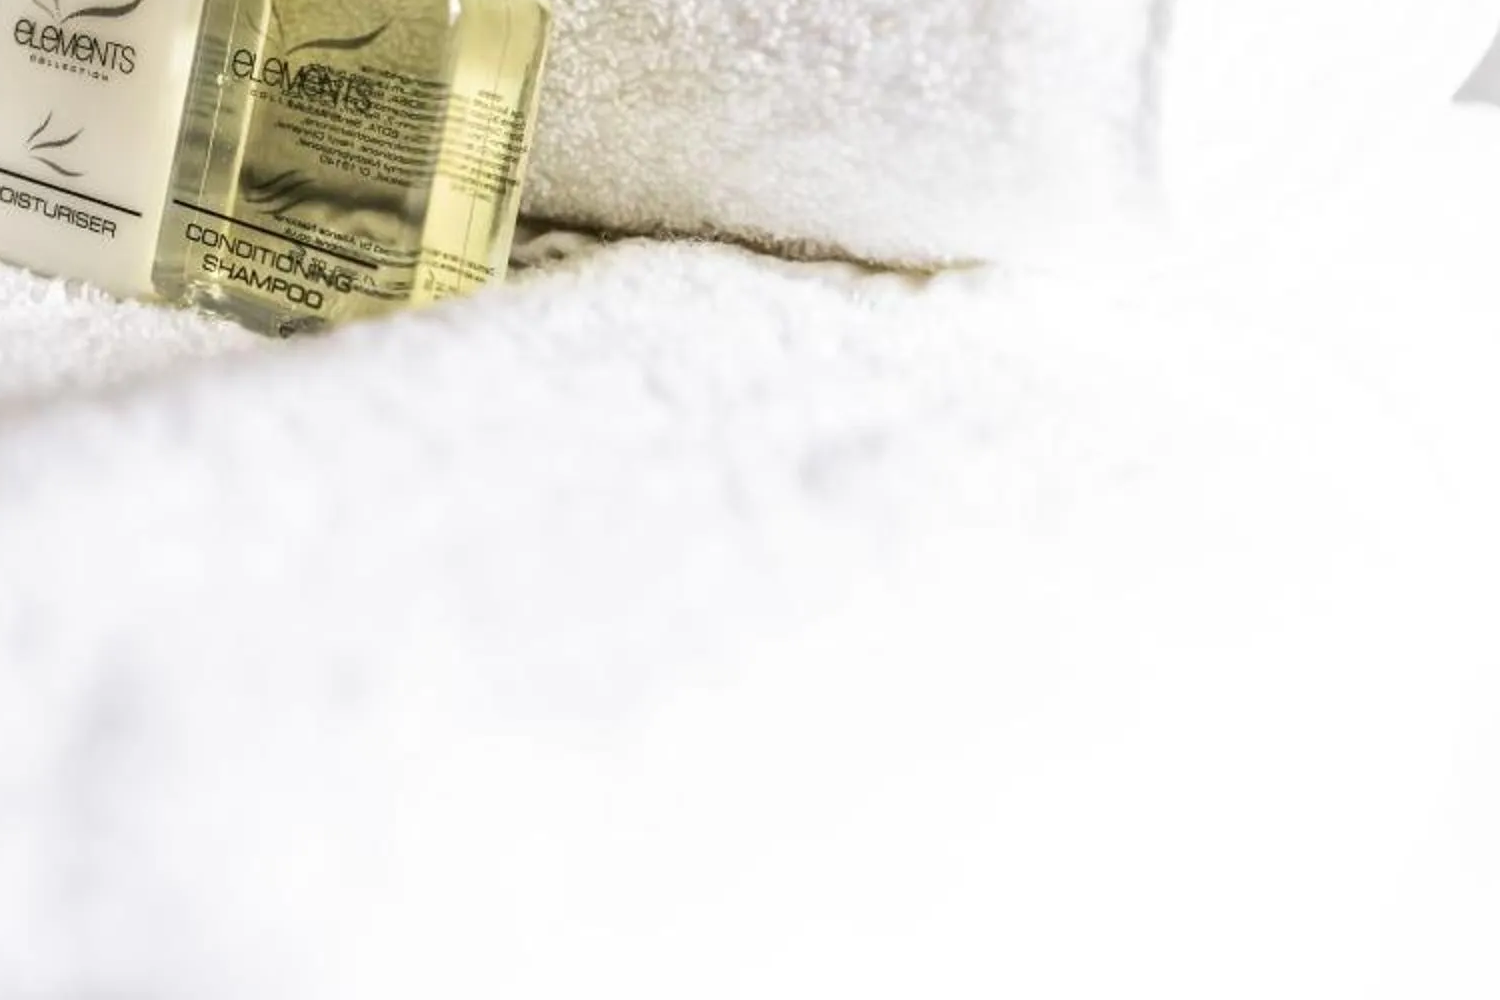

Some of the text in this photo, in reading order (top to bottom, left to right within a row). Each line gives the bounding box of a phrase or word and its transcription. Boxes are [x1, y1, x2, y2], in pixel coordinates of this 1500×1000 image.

[28, 53, 110, 82] COLLECTION
[185, 221, 354, 295] CONDITIONING
[201, 254, 324, 310] SHAMPOO
